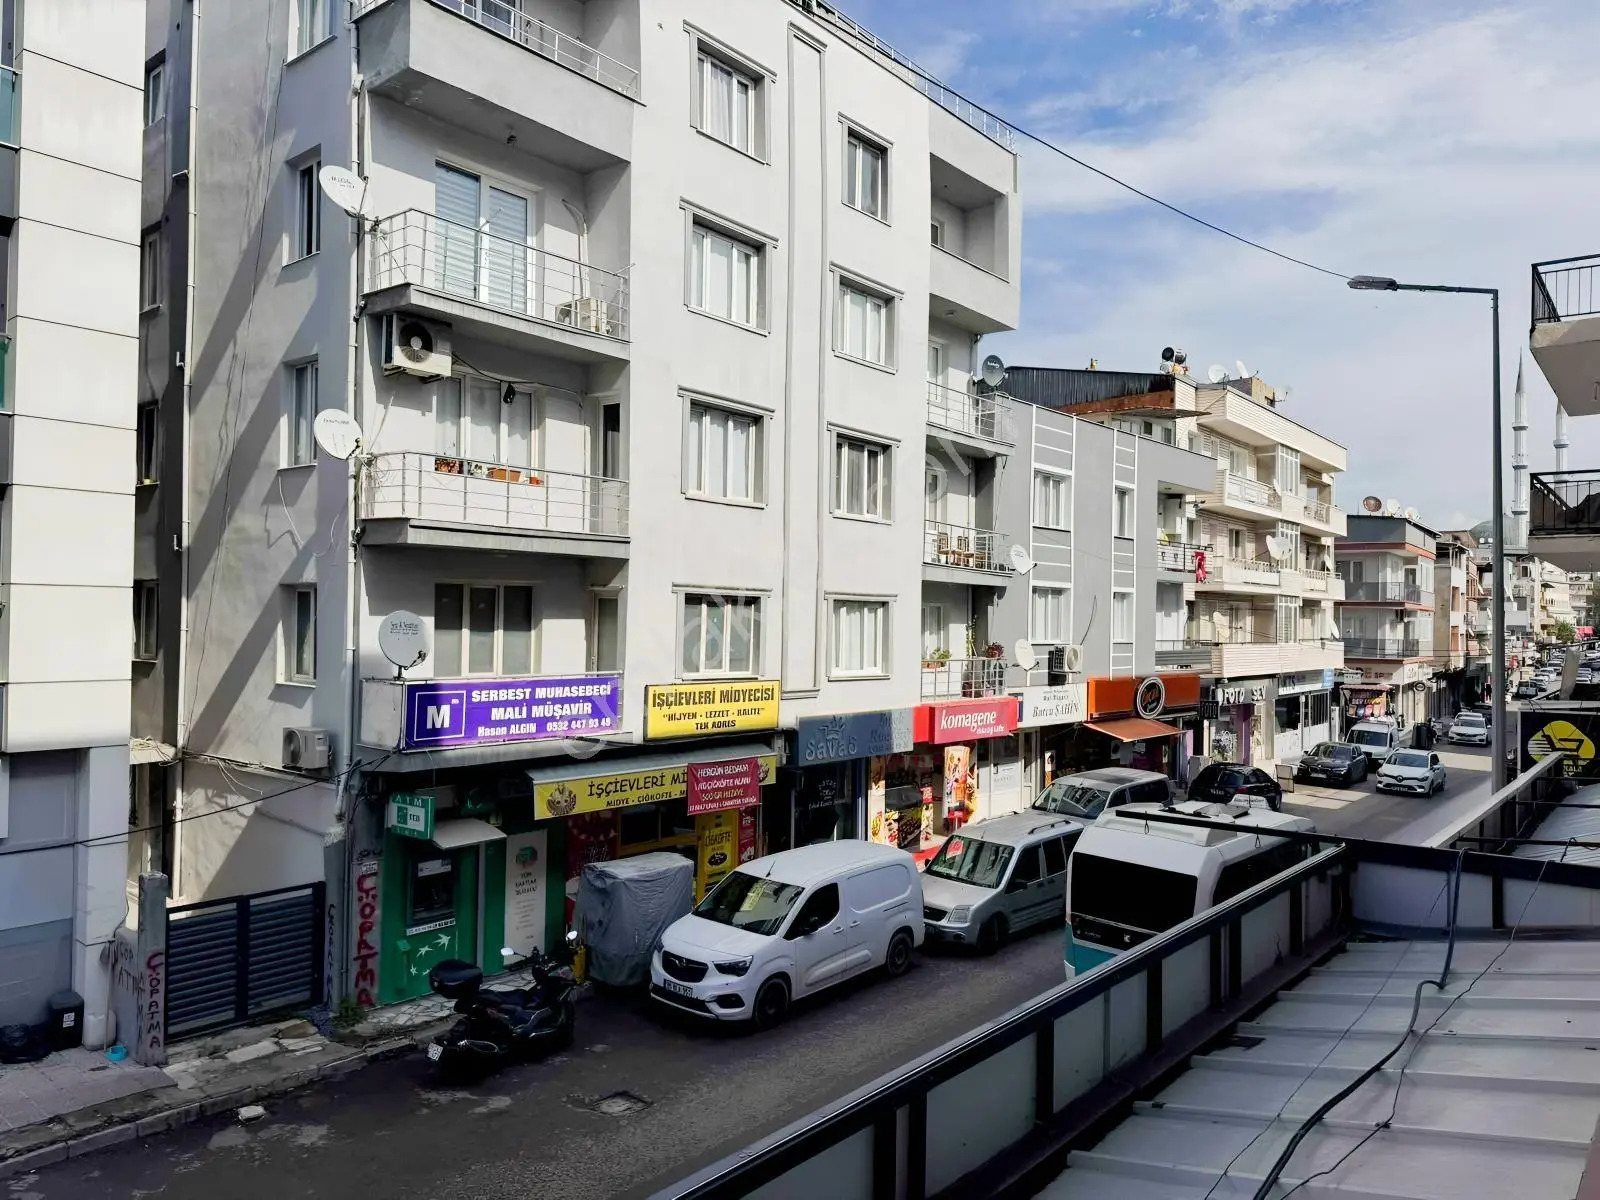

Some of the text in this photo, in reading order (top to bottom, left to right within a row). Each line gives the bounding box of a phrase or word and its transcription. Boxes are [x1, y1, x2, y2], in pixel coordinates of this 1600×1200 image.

[471, 688, 531, 703] SERBEST
[1223, 687, 1246, 706] FOTO
[491, 700, 592, 721] MALİ MÜŞAVİR
[940, 710, 997, 732] komagene
[478, 725, 507, 737] Hasan
[587, 770, 666, 799] İŞÇİEVLERİ
[395, 794, 422, 807] ATM
